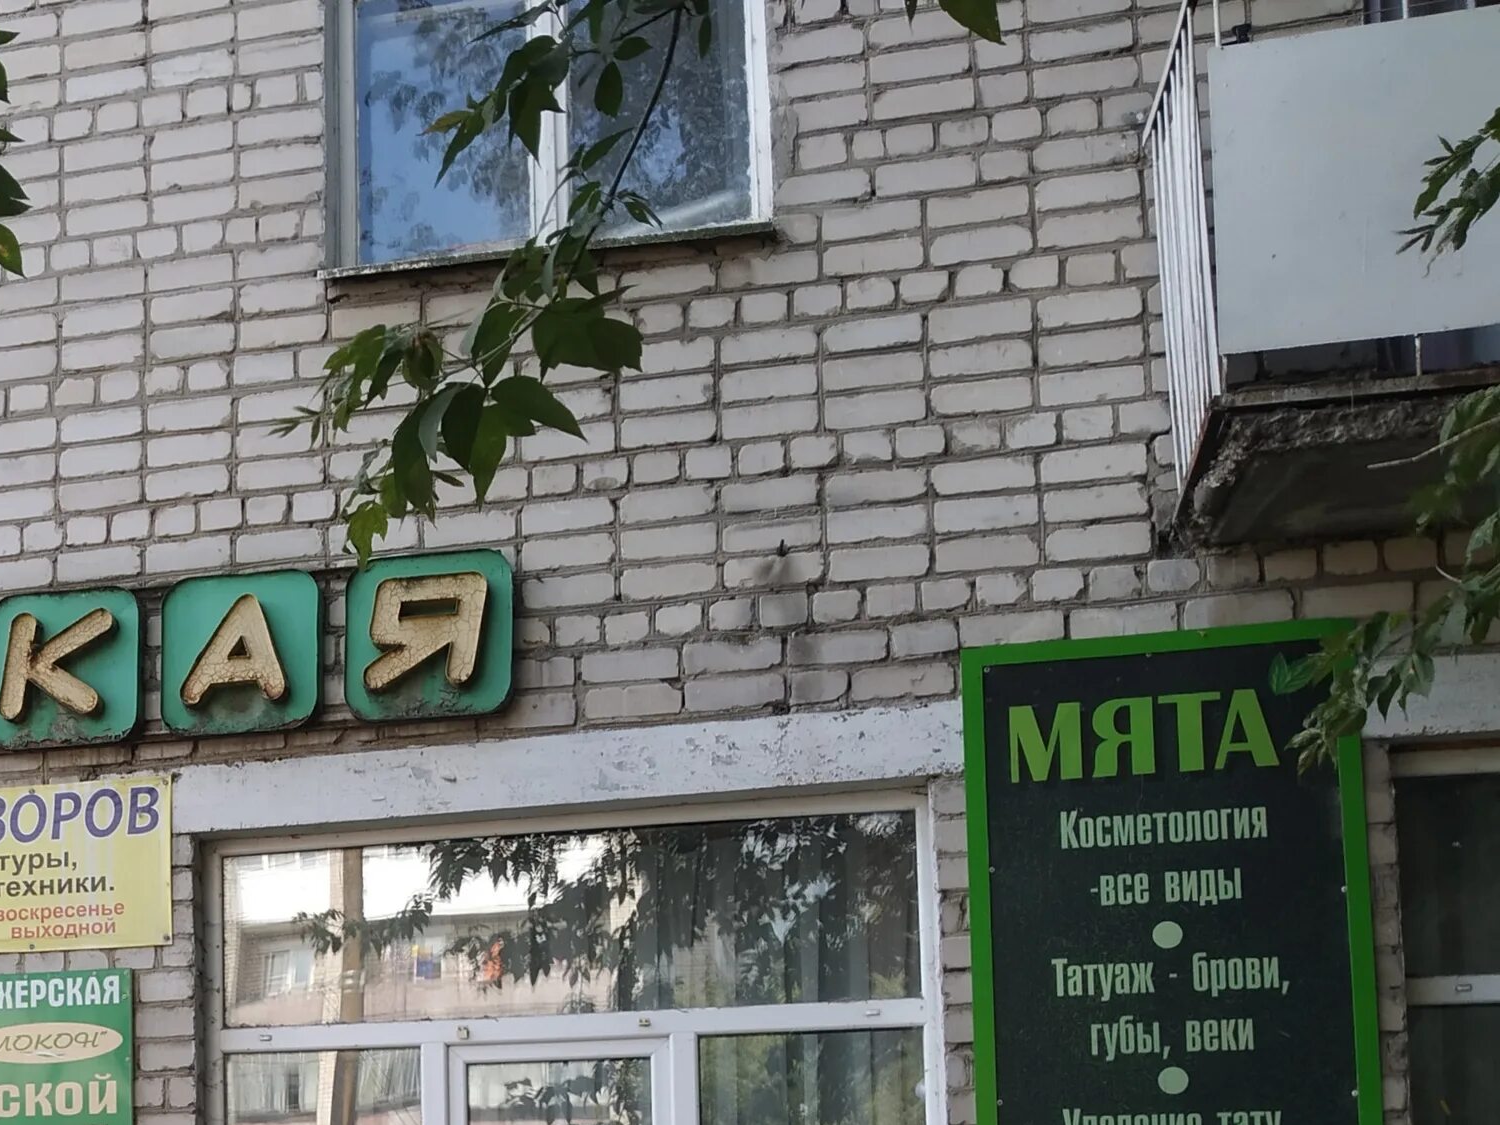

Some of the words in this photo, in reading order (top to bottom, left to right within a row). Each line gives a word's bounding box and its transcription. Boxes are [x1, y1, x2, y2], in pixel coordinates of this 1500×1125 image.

[1008, 688, 1280, 783] МЯТА
[1059, 806, 1268, 849] Косметология
[1164, 867, 1242, 906] виды
[11, 920, 116, 940] выходной
[1051, 958, 1155, 1002] Татуаж
[1192, 952, 1290, 997] брови,
[1090, 1015, 1171, 1061] губы,
[1185, 1017, 1255, 1052] веки
